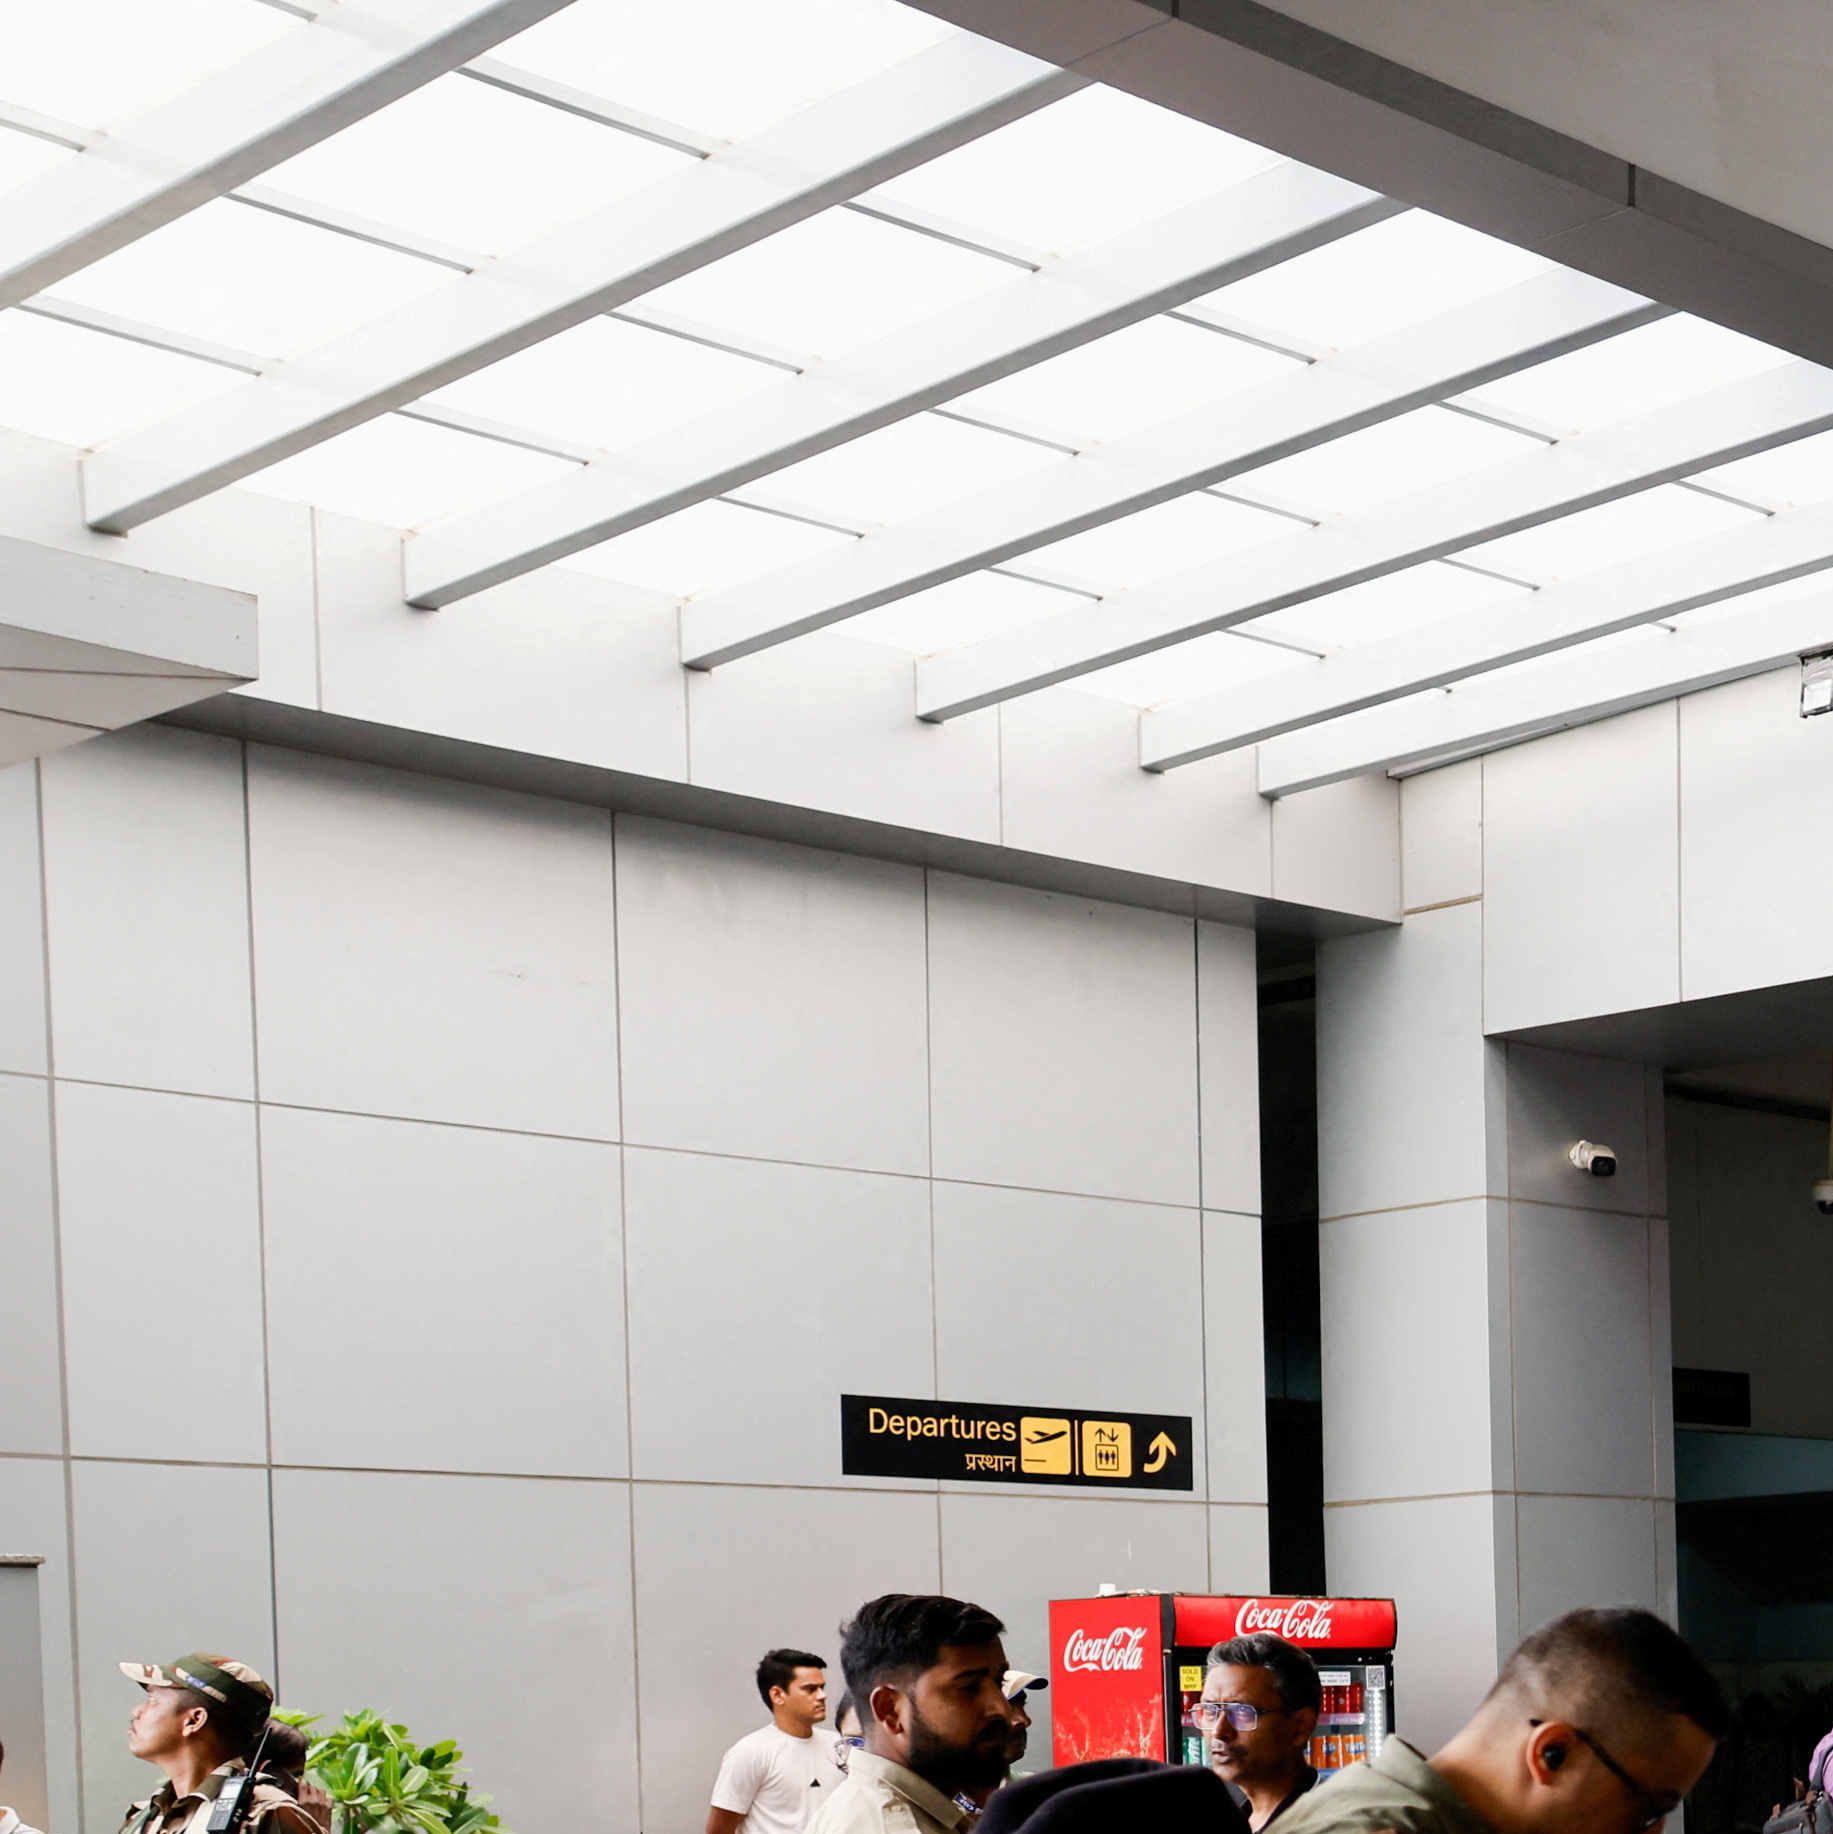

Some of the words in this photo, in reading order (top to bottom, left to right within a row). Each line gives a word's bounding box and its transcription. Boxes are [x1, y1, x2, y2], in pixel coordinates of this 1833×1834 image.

[868, 1407, 1017, 1442] Departures
[964, 1452, 1017, 1474] प्रस्थान
[1234, 1598, 1334, 1640] Coca-Cola
[1063, 1626, 1148, 1673] Coca-Cola
